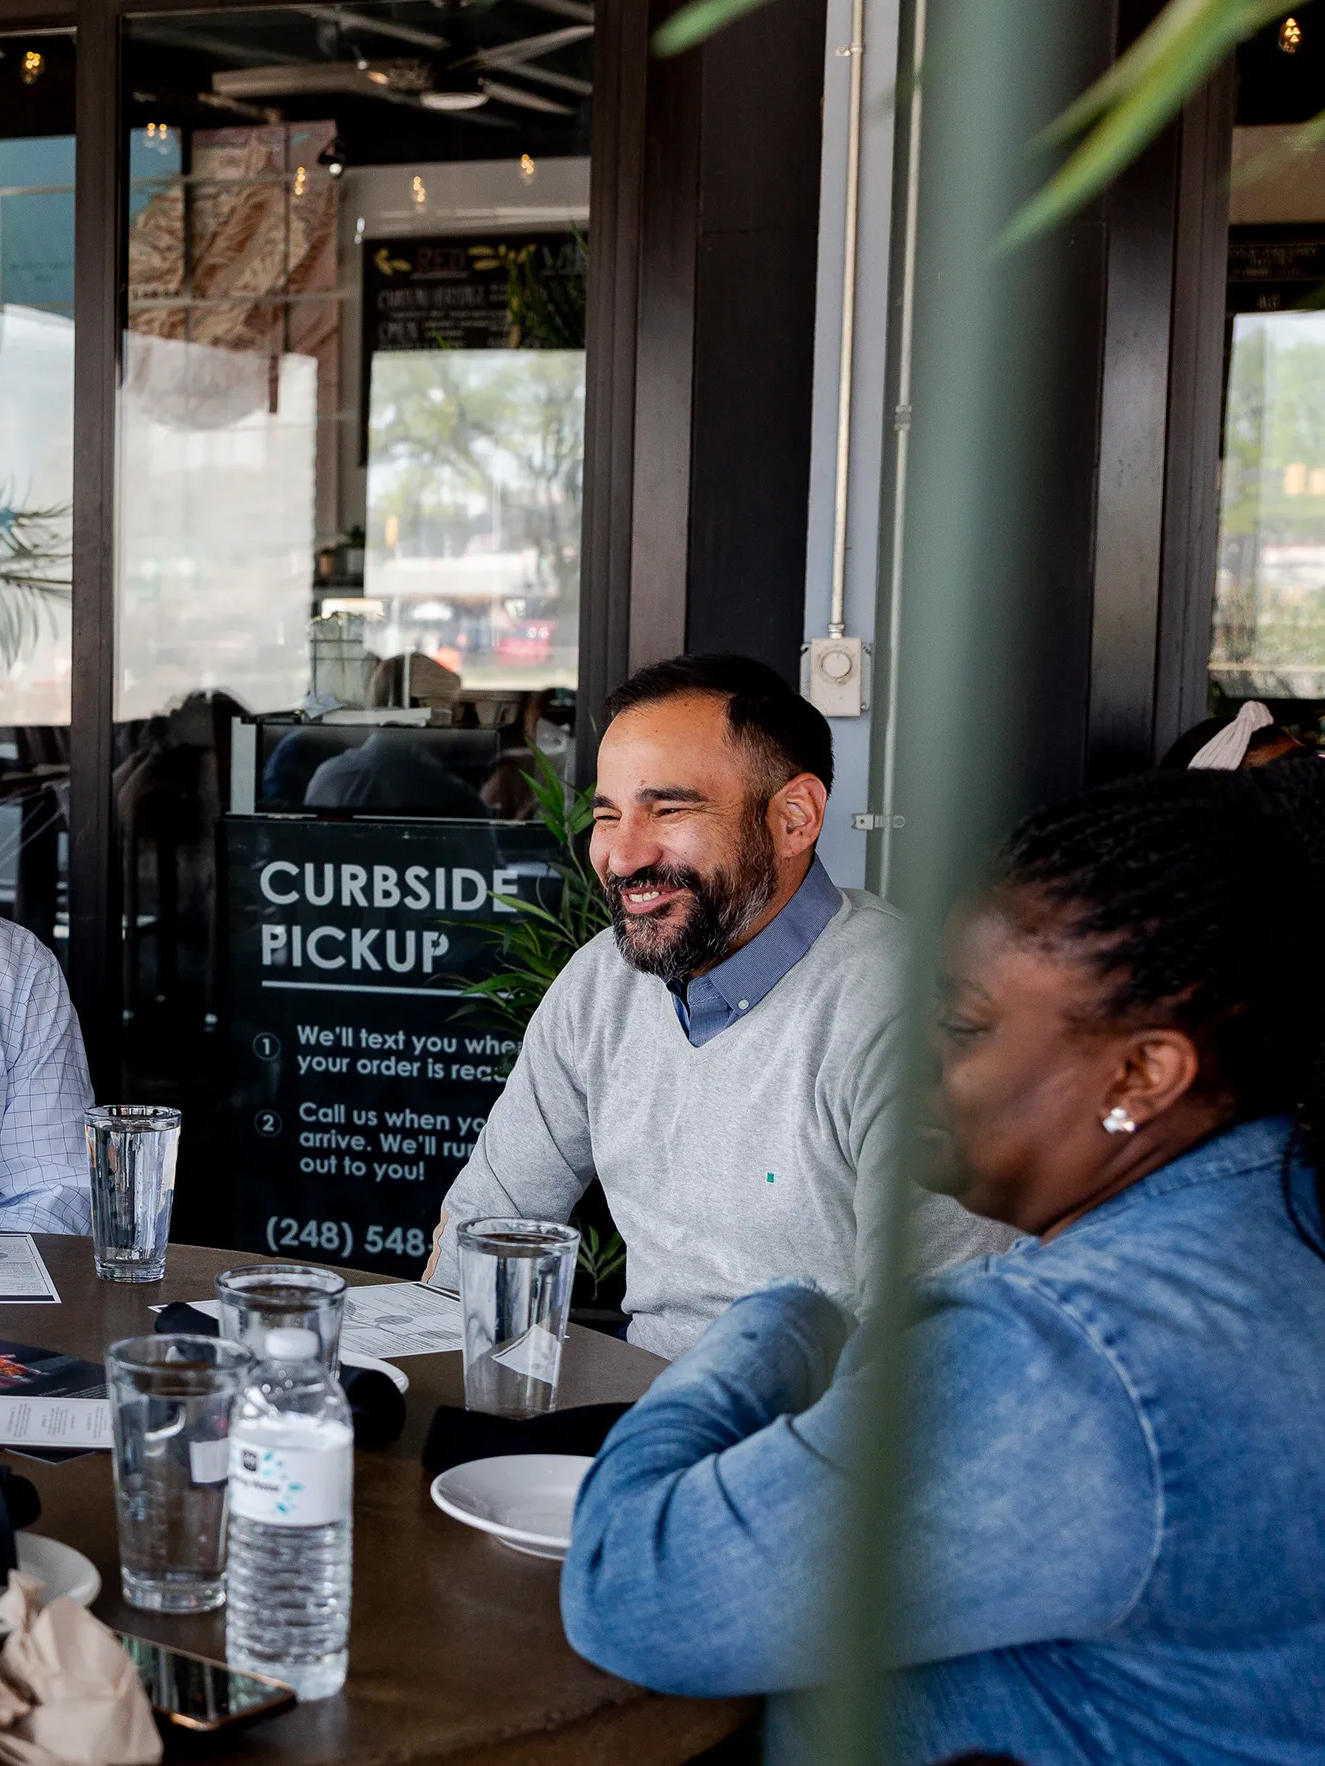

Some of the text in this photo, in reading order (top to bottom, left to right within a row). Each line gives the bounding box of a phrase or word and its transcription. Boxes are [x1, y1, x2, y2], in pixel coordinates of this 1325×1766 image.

[260, 861, 519, 913] CURBSIDE
[261, 923, 450, 974] PICKUP
[297, 1025, 354, 1047] We'll
[359, 1028, 405, 1050] text
[412, 1035, 457, 1056] you
[297, 1056, 350, 1075] your
[356, 1056, 421, 1077] order
[427, 1058, 445, 1079] is
[298, 1102, 346, 1124] Call
[352, 1110, 378, 1126] us
[384, 1107, 450, 1131] when
[299, 1129, 373, 1152] arrive.
[379, 1132, 436, 1156] We'll
[299, 1155, 425, 1182] out to you!
[266, 1215, 354, 1258] (248)
